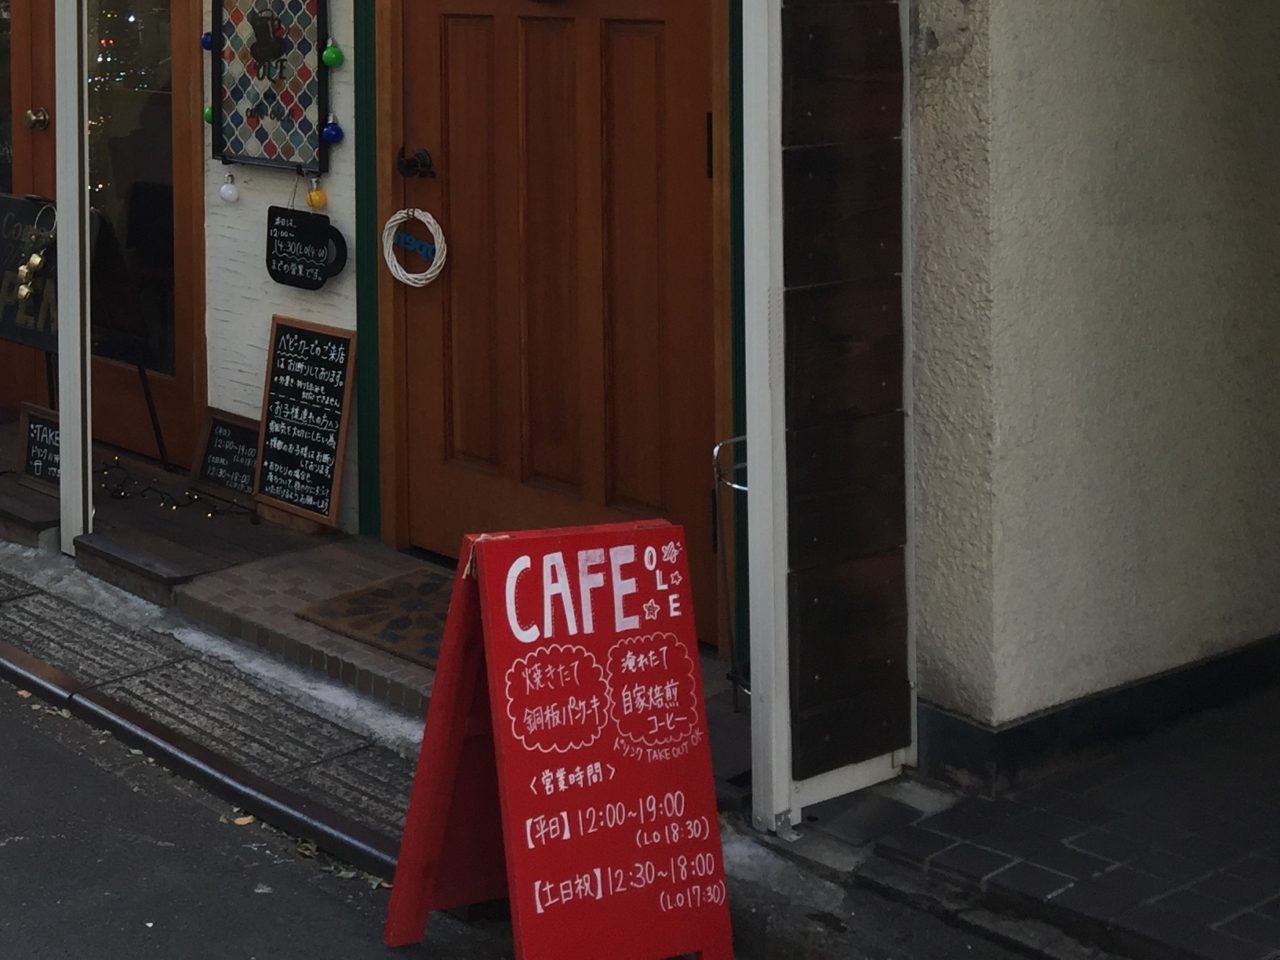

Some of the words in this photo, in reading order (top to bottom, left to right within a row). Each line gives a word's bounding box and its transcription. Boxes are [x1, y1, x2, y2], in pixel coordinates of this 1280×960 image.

[505, 545, 640, 643] CAFE
[522, 660, 580, 695] 焼きたて
[622, 679, 680, 715] 自家焙煎
[647, 713, 688, 735] コーヒー
[646, 747, 671, 763] TAKE
[671, 742, 689, 760] OUT
